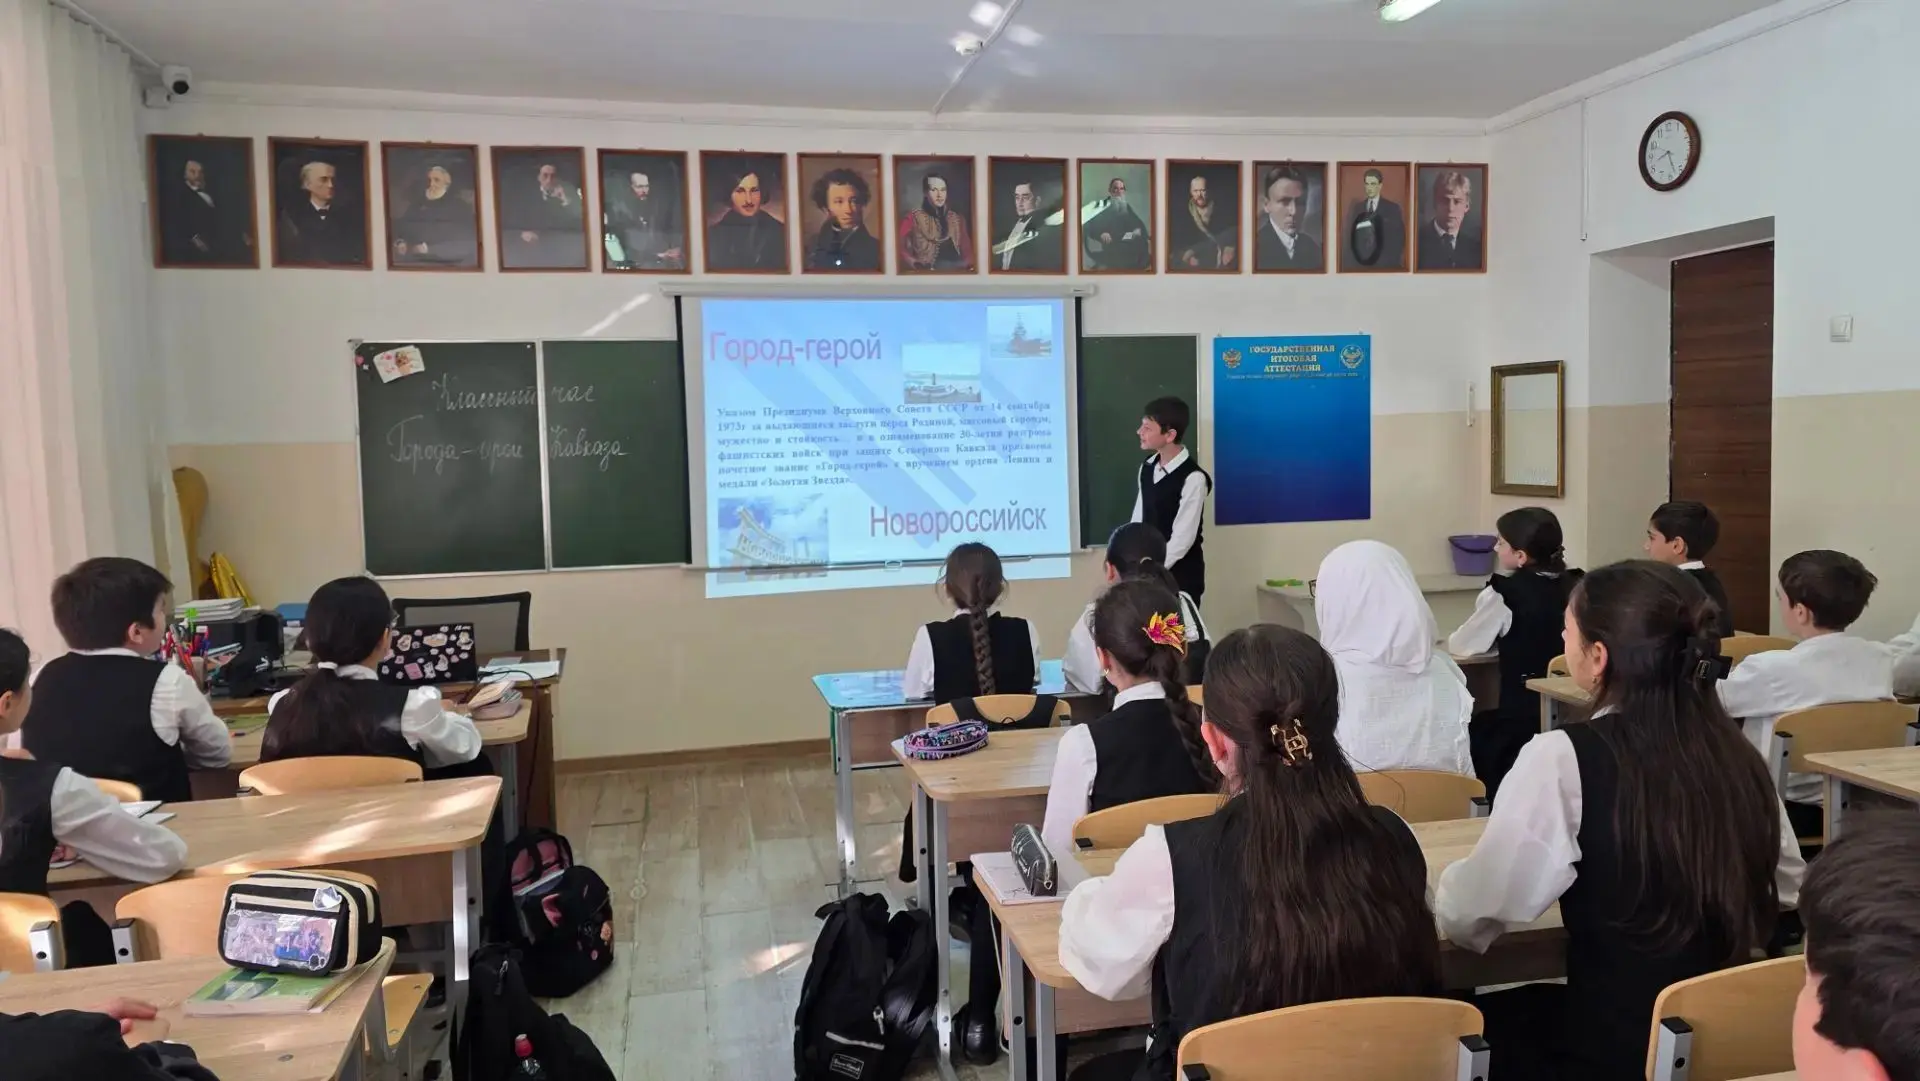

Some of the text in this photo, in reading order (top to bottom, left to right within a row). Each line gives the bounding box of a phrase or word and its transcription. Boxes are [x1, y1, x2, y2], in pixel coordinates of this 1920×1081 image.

[709, 331, 881, 367] Город-герой
[1249, 344, 1335, 354] ГОСУДАРСТВЕННАЯ
[1270, 354, 1317, 363] ИТОГОВАЯ
[1263, 364, 1321, 373] АТТЕСТАЦИЯ
[432, 372, 595, 412] Классный час
[717, 400, 1051, 419] Указом Президиума Верховного Совета СССР от 14 сентября
[752, 423, 762, 431] за
[765, 421, 834, 432] выдающиеся
[838, 419, 877, 431] заслуги
[880, 418, 909, 430] перед
[912, 417, 956, 428] Родиной,
[960, 415, 1006, 426] массовый
[1010, 415, 1052, 426] героизм,
[550, 424, 629, 471] Кавказа
[717, 437, 769, 448] мужество
[880, 431, 955, 441] ознаменование
[960, 429, 1002, 440] 30-летия
[1008, 428, 1052, 439] разгрома
[718, 450, 784, 462] фашистских
[792, 448, 822, 459] войск
[829, 448, 849, 458] при
[856, 446, 892, 456] защите
[898, 446, 950, 457] Северного
[956, 443, 996, 454] Кавказа
[718, 465, 767, 475] почетное
[774, 463, 809, 473] звание
[906, 457, 959, 470] вручением
[965, 457, 998, 467] ордена
[1004, 455, 1040, 464] Ленина
[718, 479, 758, 489] медали
[761, 476, 808, 487] «Золотая
[870, 500, 1047, 543] Новороссийск
